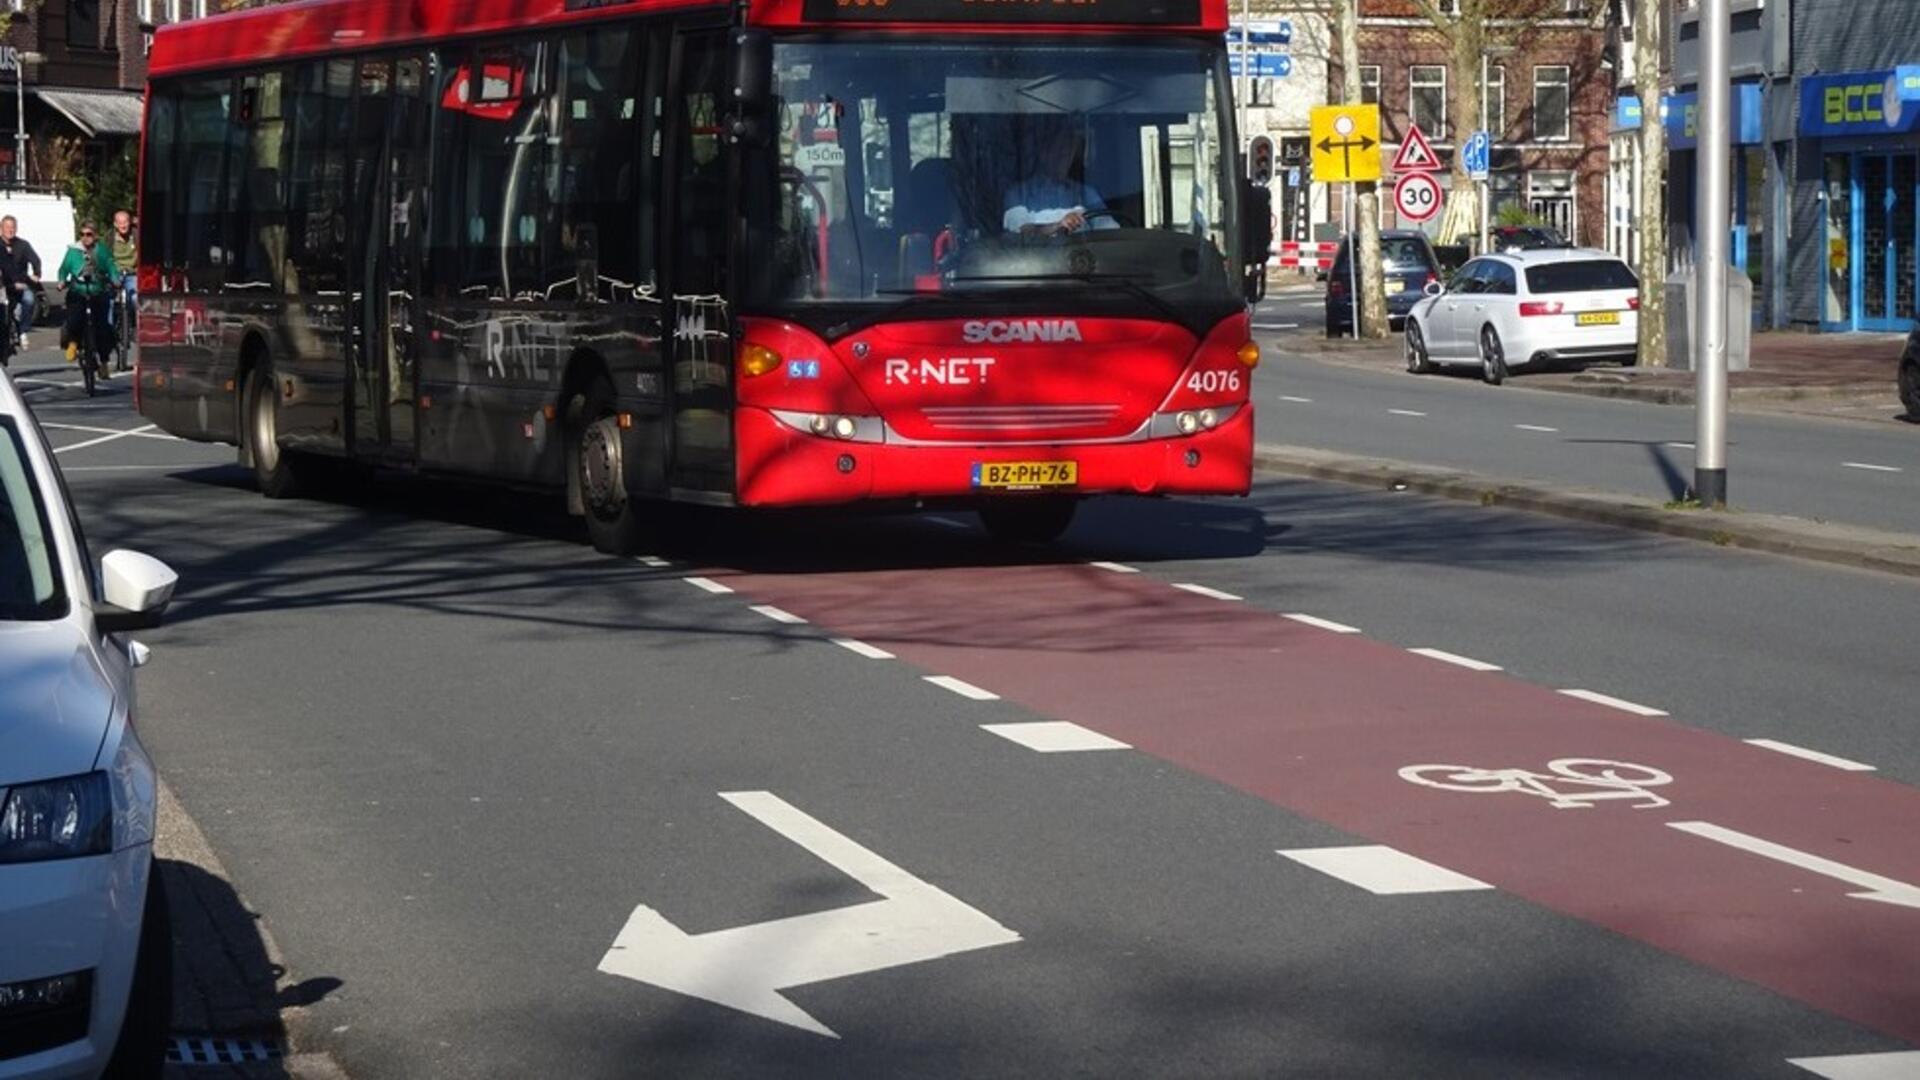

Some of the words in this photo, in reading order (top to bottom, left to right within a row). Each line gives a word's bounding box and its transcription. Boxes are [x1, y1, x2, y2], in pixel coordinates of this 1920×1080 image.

[1824, 84, 1883, 123] BCC
[1404, 187, 1433, 205] 30
[963, 320, 1082, 342] SCANIA
[1187, 369, 1240, 393] 4076
[989, 465, 1071, 482] BZ-PH-76
